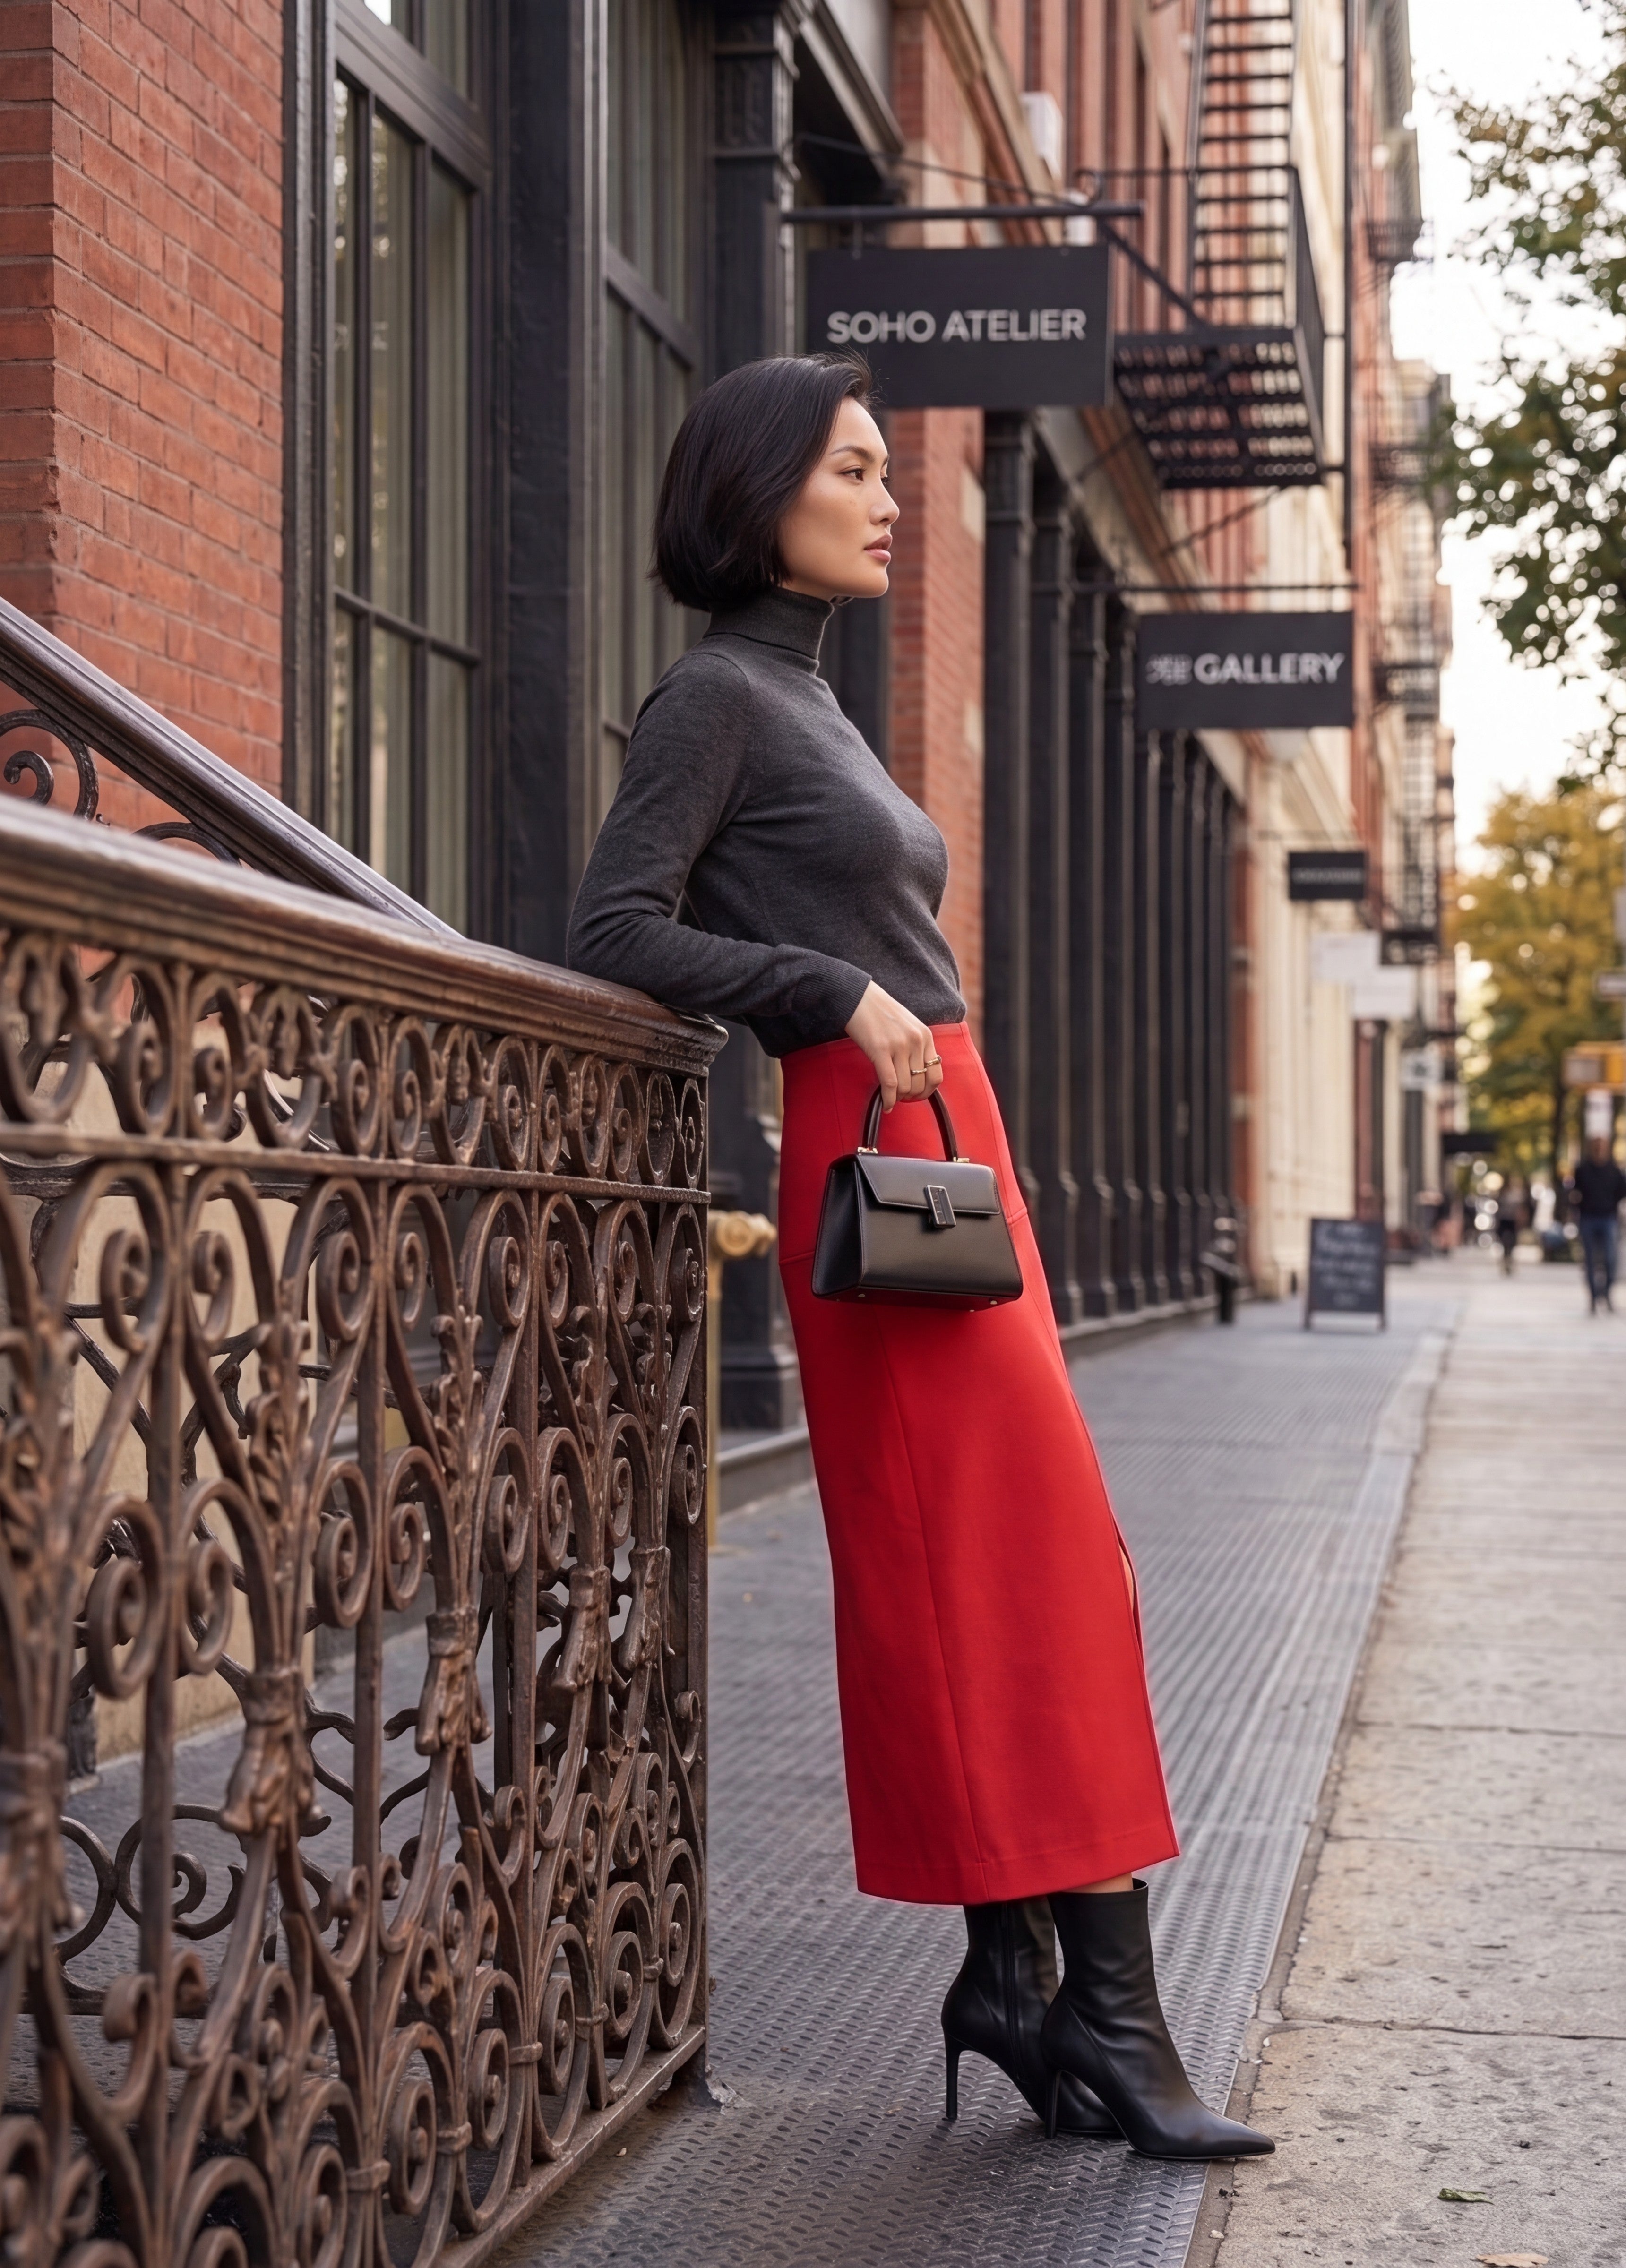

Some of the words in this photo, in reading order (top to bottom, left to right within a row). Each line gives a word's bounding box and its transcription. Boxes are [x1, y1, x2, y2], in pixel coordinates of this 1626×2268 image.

[827, 310, 936, 343] SOHO
[942, 309, 1086, 341] ATELIER
[1194, 652, 1345, 685] GALLERY
